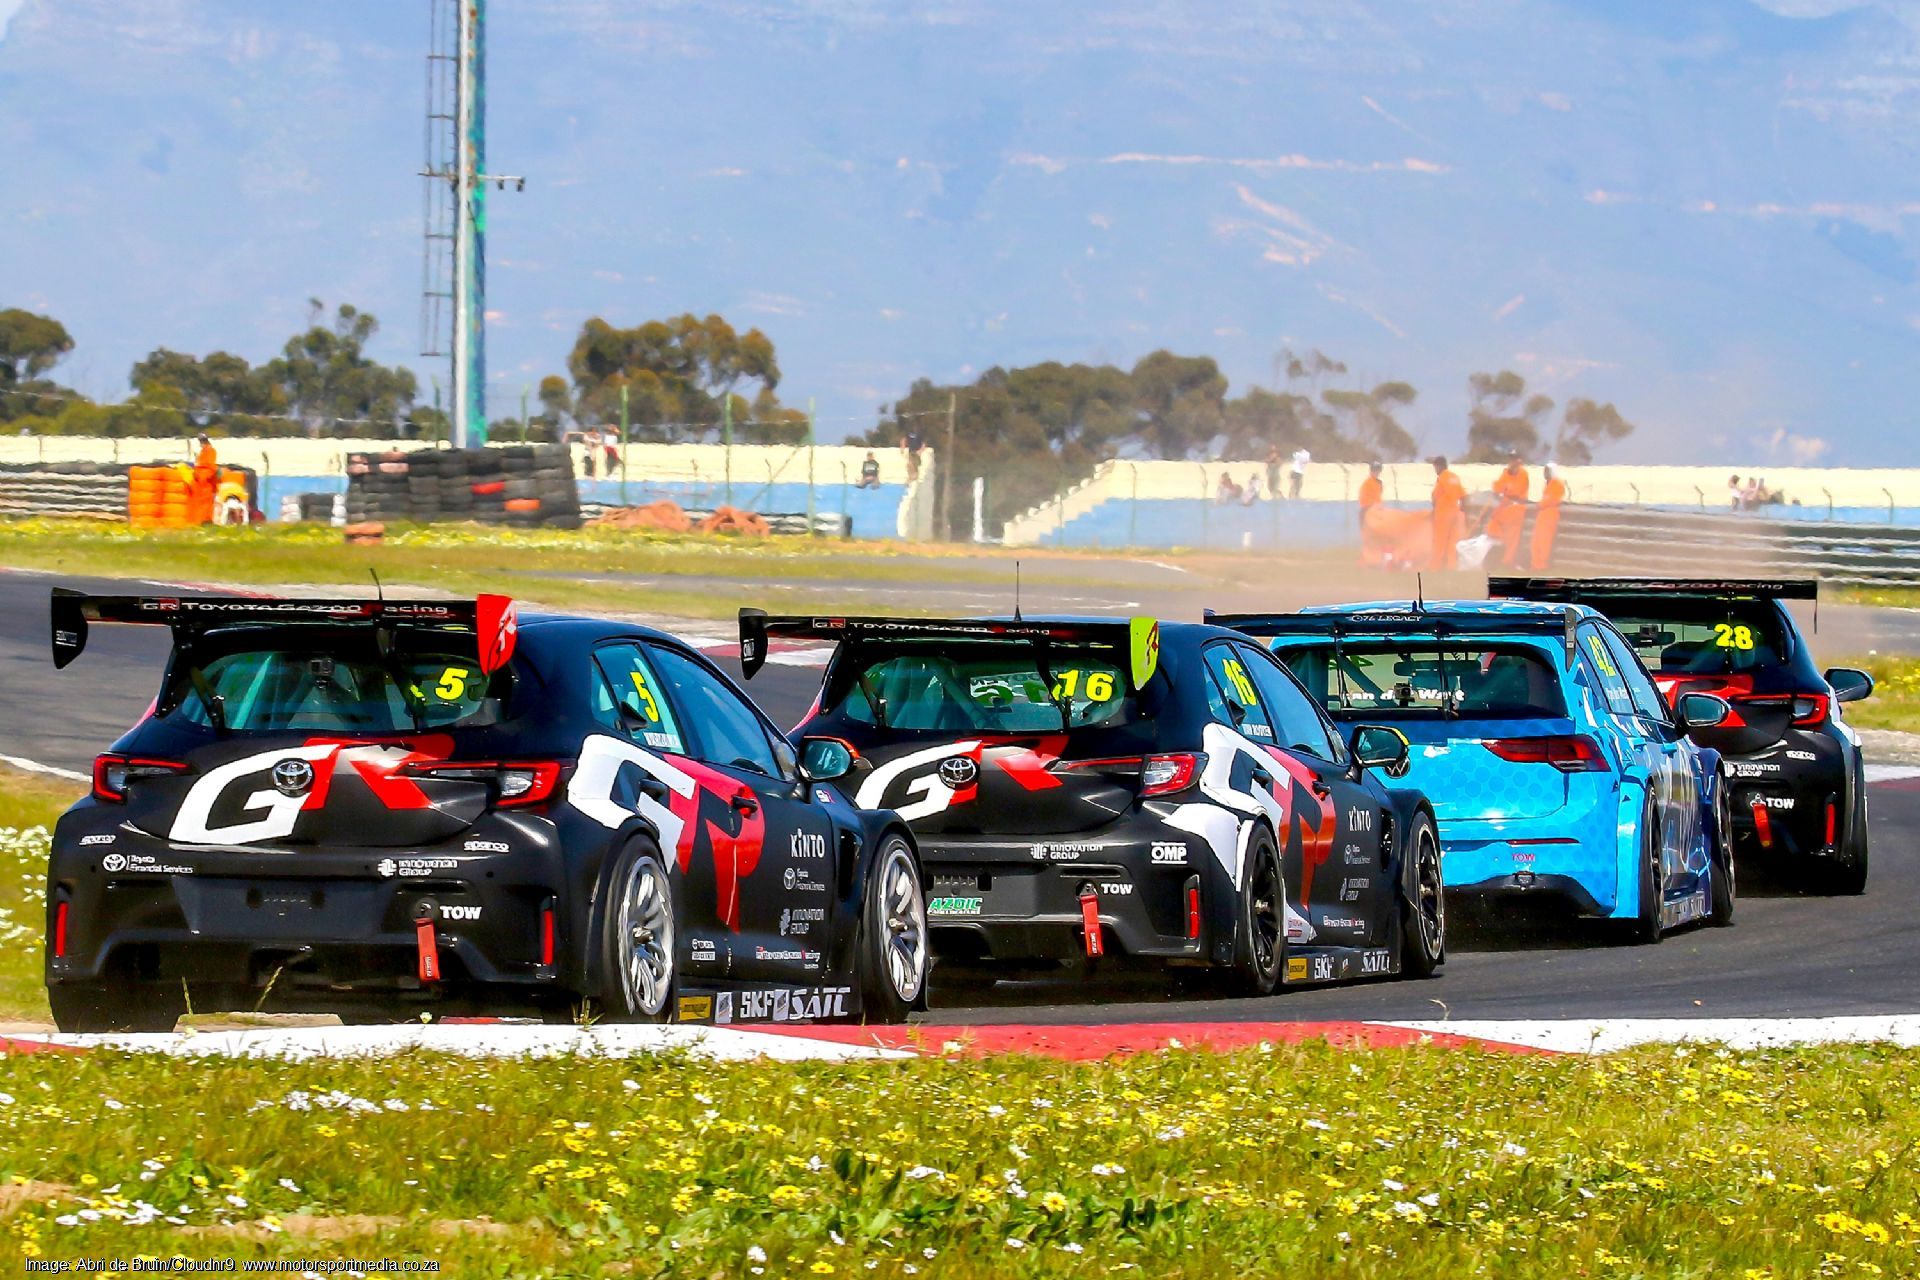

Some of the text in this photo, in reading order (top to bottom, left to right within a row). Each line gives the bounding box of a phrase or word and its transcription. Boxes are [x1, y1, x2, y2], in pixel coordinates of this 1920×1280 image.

[1714, 624, 1753, 649] 28
[1587, 635, 1616, 677] 42
[435, 668, 468, 700] 5
[1058, 669, 1113, 702] 16
[1222, 659, 1257, 705] 16
[630, 672, 659, 722] 5
[1766, 797, 1795, 809] TOW
[1050, 843, 1103, 852] INNOVATION
[1050, 851, 1080, 859] GROUP
[1151, 846, 1188, 860] OMP
[1101, 883, 1133, 895] TOW
[440, 905, 482, 919] TOW
[739, 991, 774, 1019] SKF
